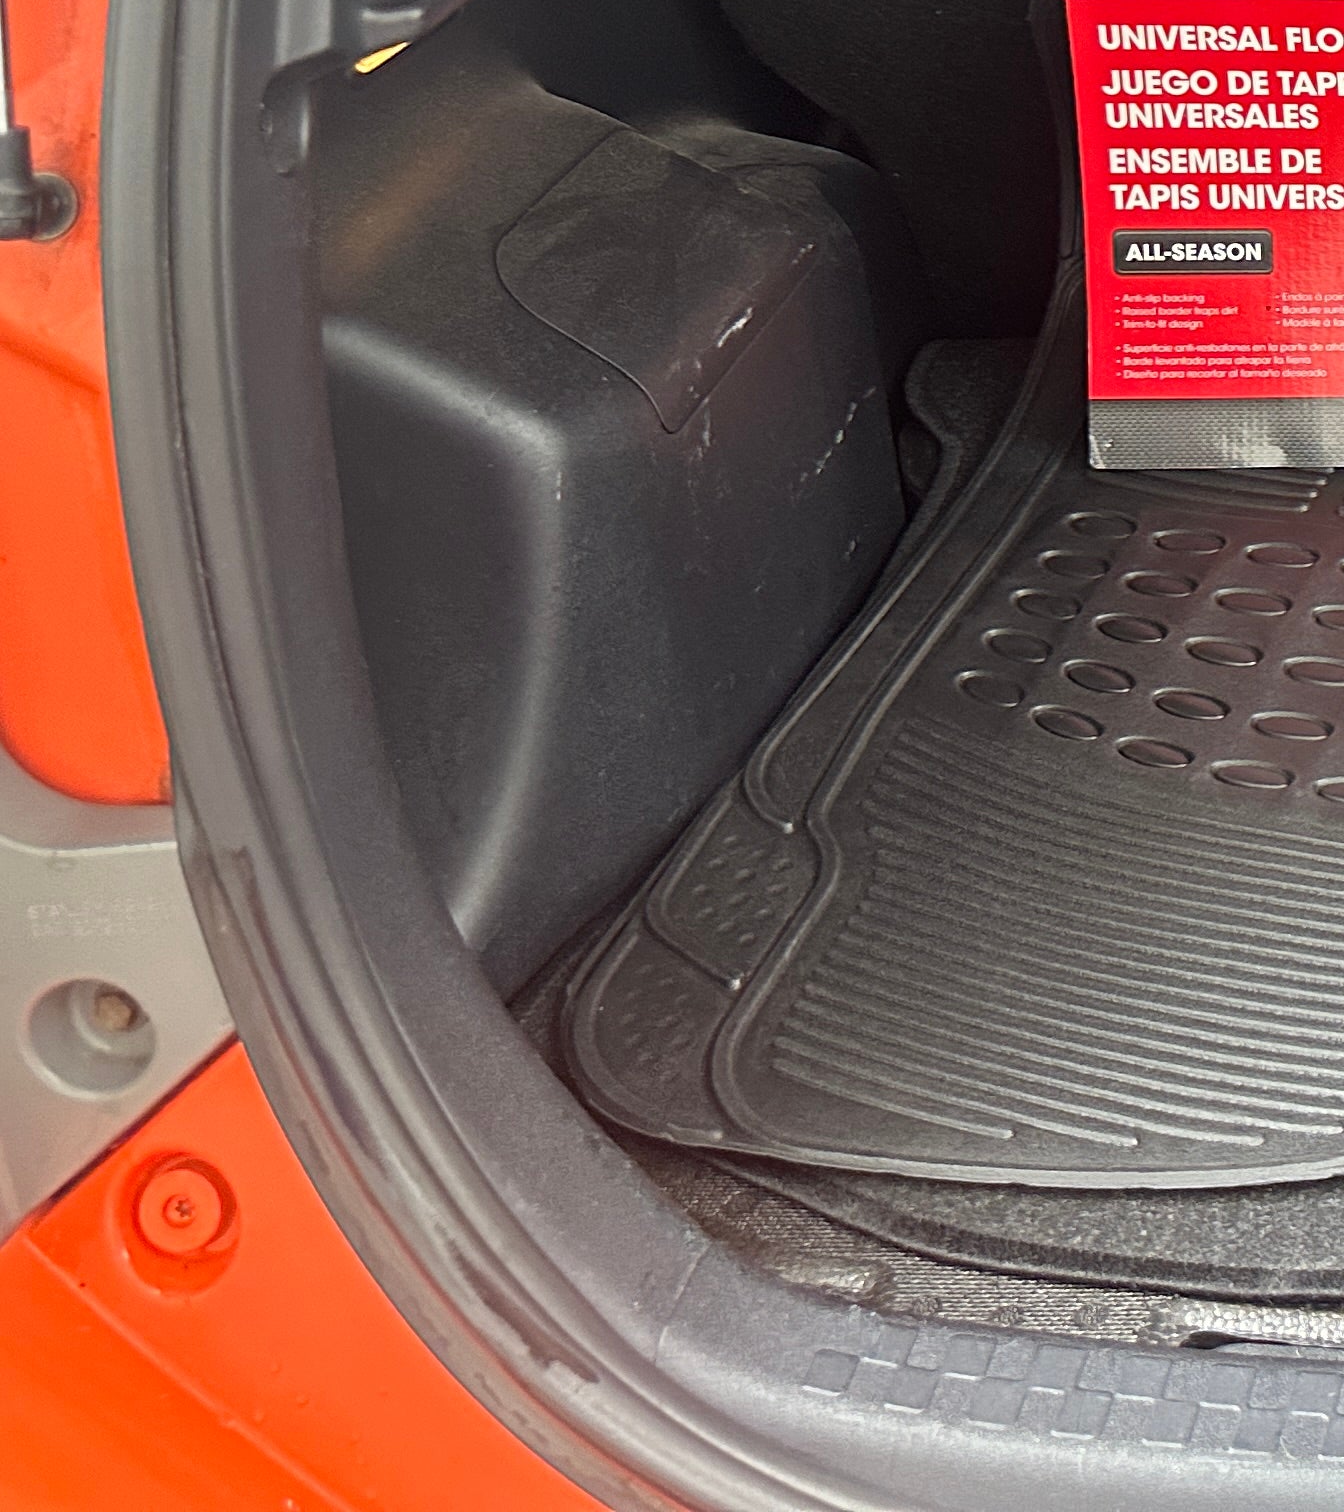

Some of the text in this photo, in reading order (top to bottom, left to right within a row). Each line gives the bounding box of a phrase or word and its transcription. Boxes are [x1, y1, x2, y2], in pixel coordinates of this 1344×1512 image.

[1097, 24, 1279, 52] UNIVERSAL
[1101, 69, 1219, 96] JUEGO
[1226, 70, 1270, 96] DE
[1104, 102, 1320, 129] UNIVERSALES
[1107, 148, 1322, 174] ENSEMBLE DE
[1108, 183, 1200, 210] TAPIS
[1125, 243, 1263, 262] ALL-SEASON
